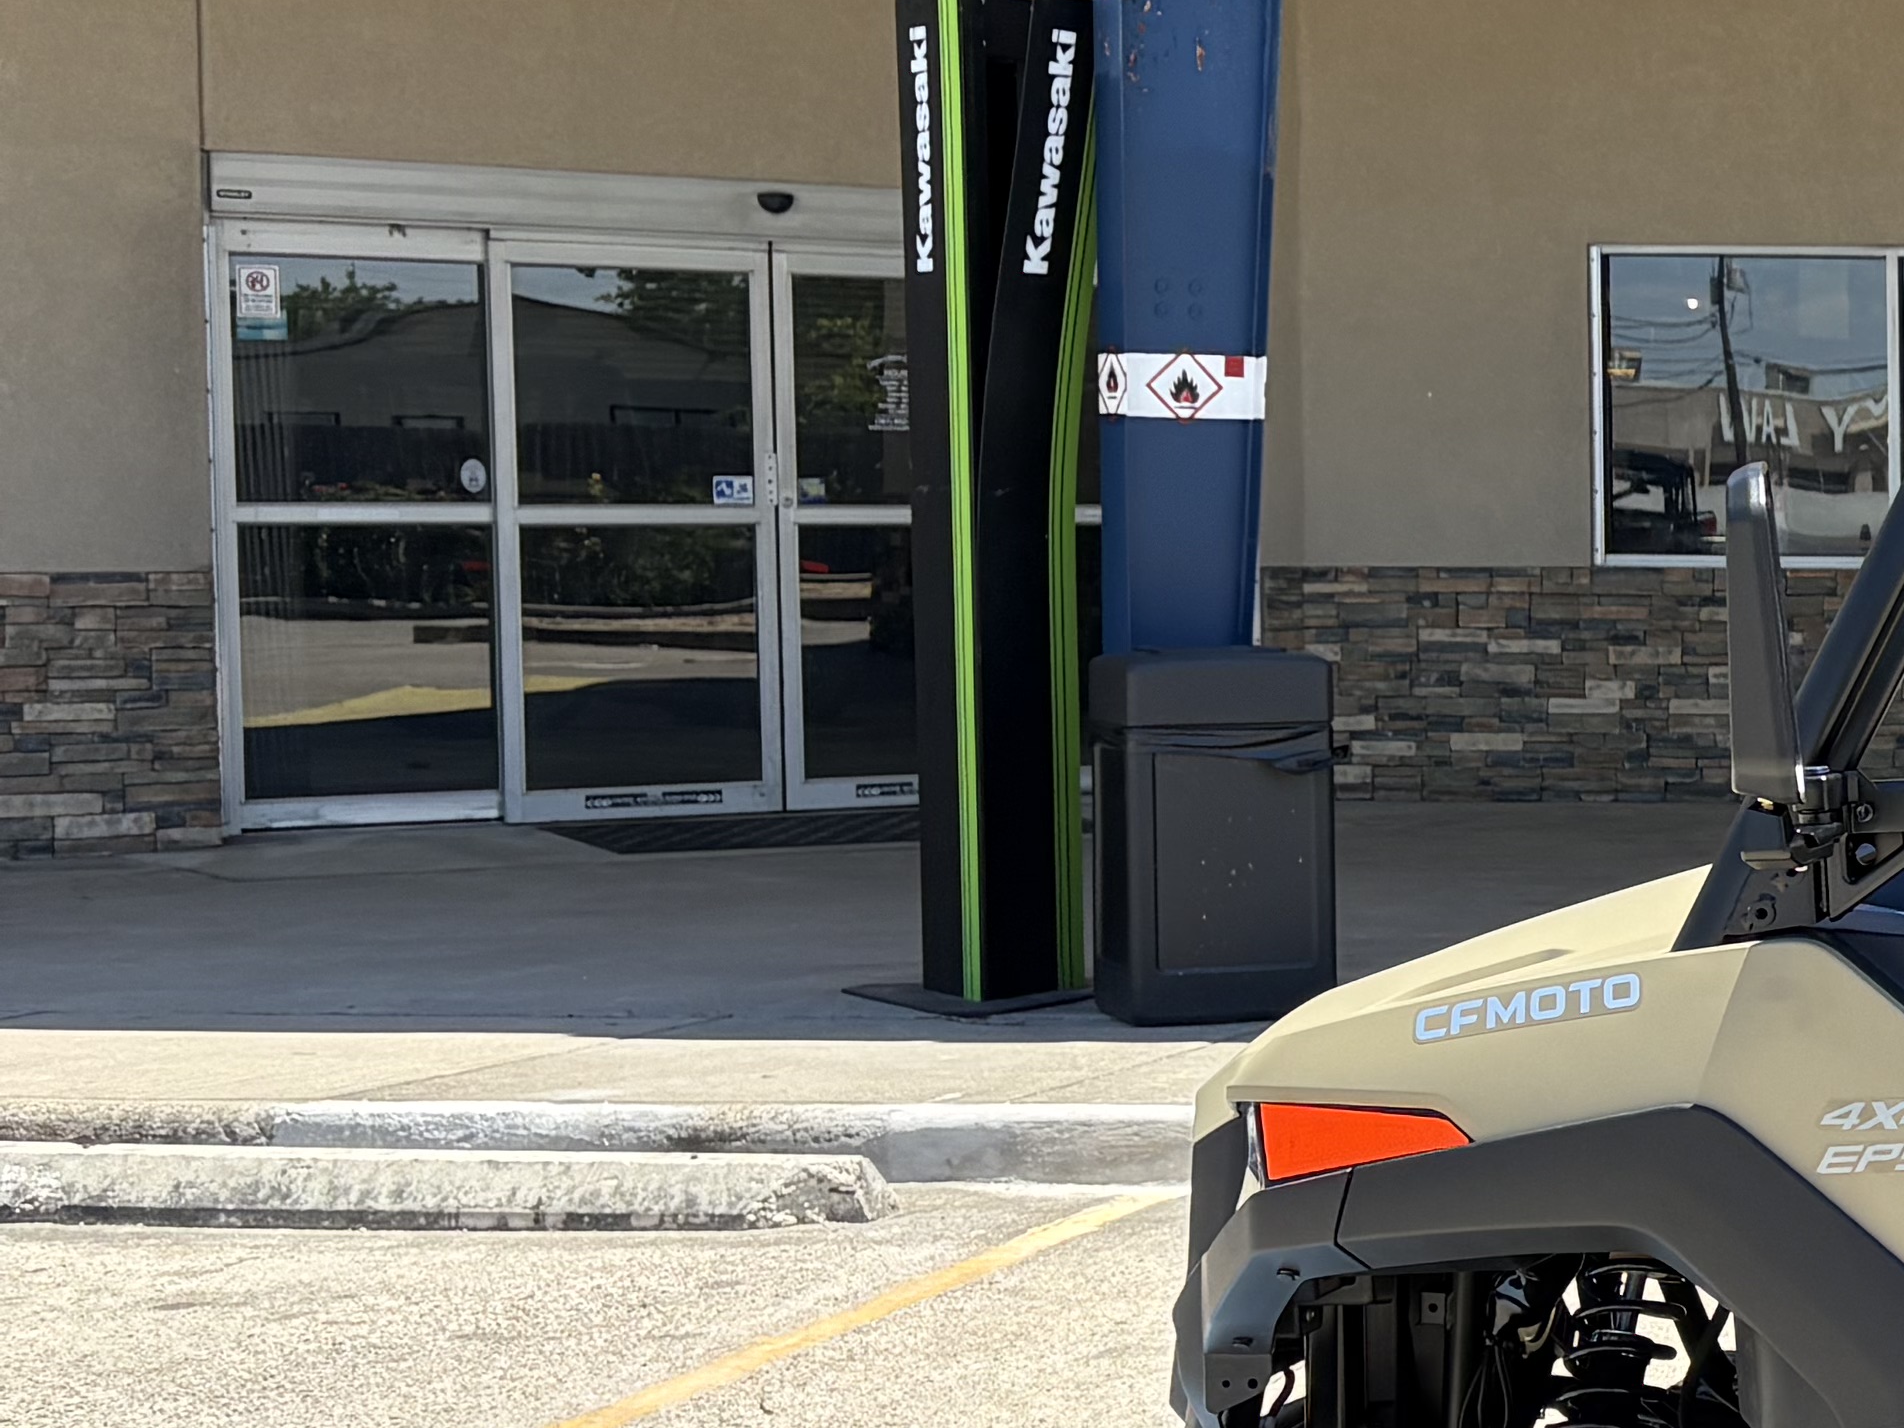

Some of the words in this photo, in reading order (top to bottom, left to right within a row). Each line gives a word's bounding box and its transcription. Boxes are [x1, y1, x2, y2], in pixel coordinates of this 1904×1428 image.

[909, 24, 934, 274] Kawasaki
[1022, 28, 1077, 276] Kawasaki
[1415, 973, 1642, 1043] CFMOTO
